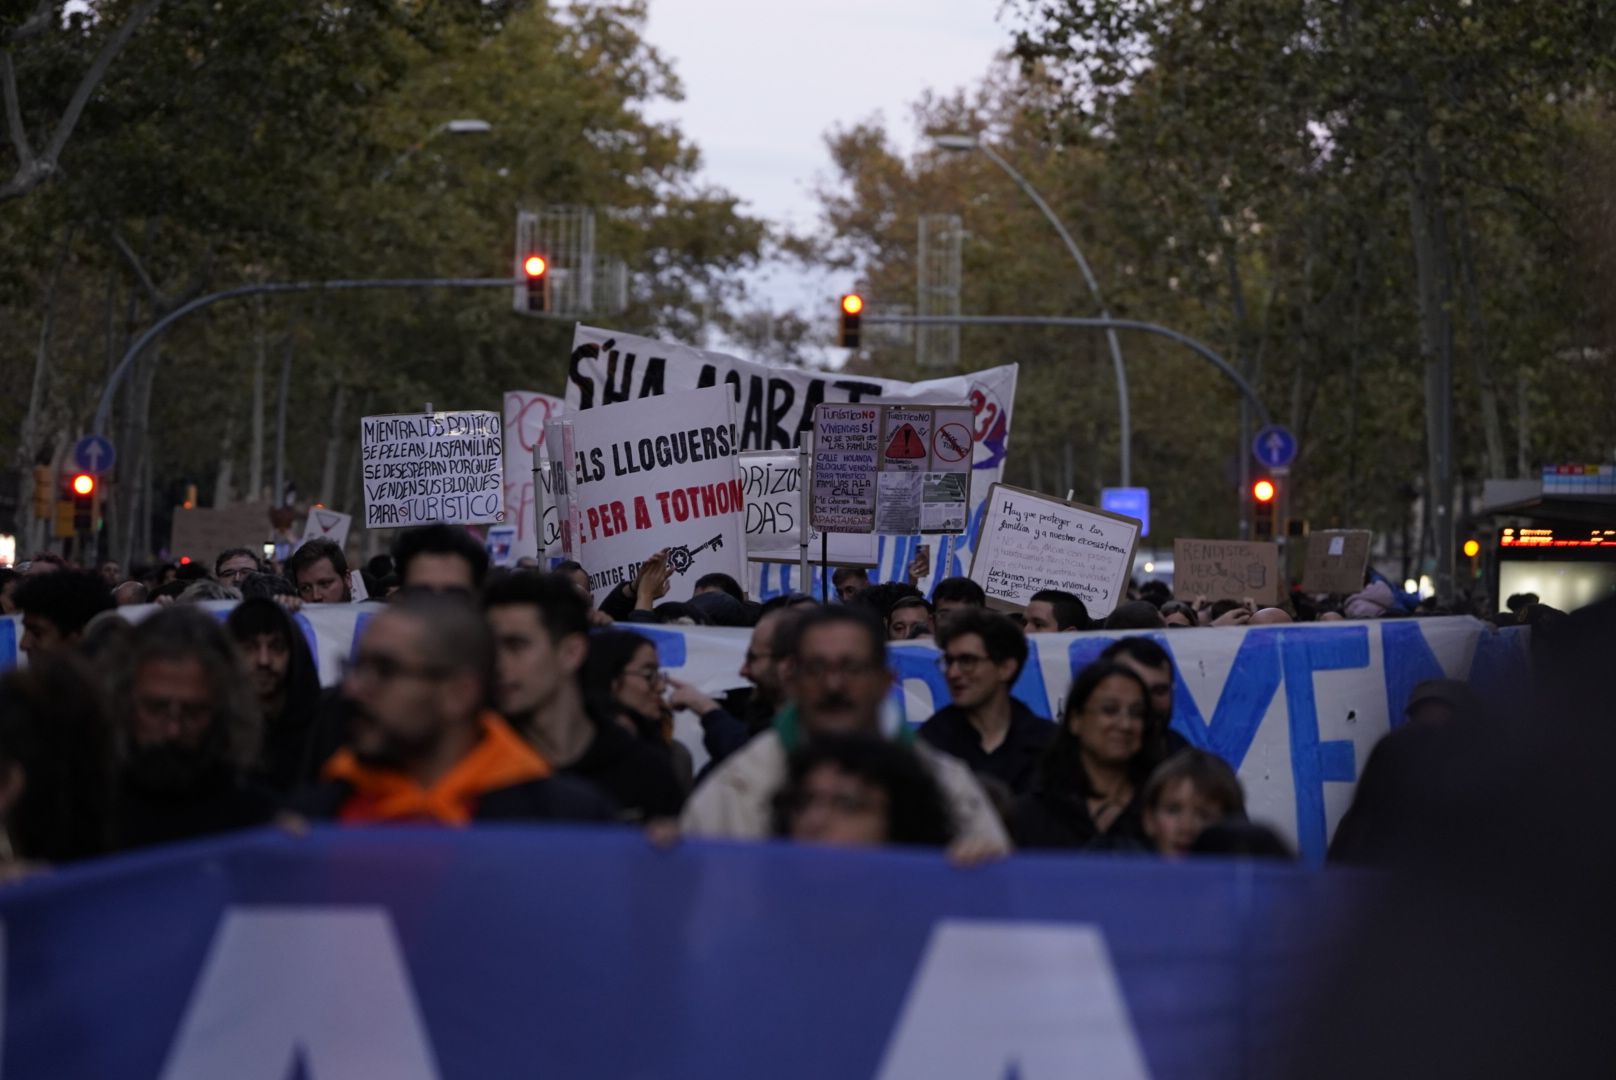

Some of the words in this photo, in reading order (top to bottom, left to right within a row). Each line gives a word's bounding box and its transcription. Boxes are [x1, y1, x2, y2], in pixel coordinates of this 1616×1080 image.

[862, 410, 876, 419] NO
[861, 420, 874, 433] SÍ
[363, 445, 377, 460] SE
[429, 441, 450, 459] LAS
[612, 423, 737, 477] LLOGUERS!
[816, 453, 838, 462] CALLE
[364, 464, 381, 479] SE
[383, 460, 447, 479] DESESPERAN
[449, 458, 498, 475] PORQUE
[816, 462, 847, 471] BLOQUE
[366, 480, 417, 501] VENDEN
[418, 479, 442, 496] SUS
[442, 473, 500, 494] BLOQUES
[831, 488, 865, 497] CALLE
[368, 504, 399, 524] PARA
[587, 501, 628, 540] PER
[634, 496, 652, 529] A
[1002, 501, 1022, 522] Hay
[1023, 511, 1037, 522] que
[1033, 528, 1040, 540] y
[1041, 530, 1047, 538] a
[1048, 531, 1076, 543] nuestro
[988, 566, 1025, 582] Luchamos
[1027, 575, 1043, 587] por
[1044, 578, 1059, 587] una
[1102, 588, 1109, 600] y
[1000, 577, 1009, 586] la
